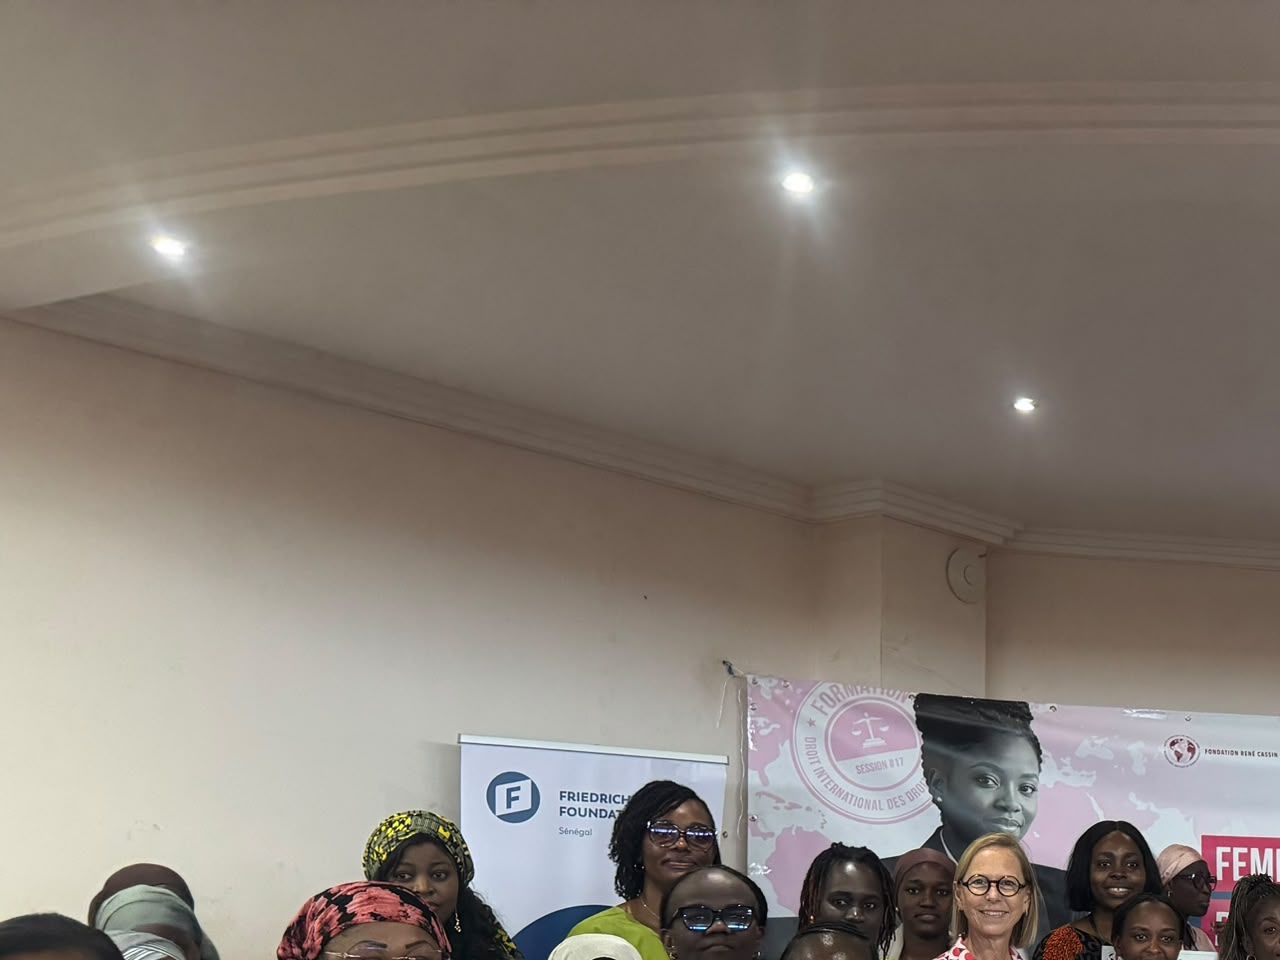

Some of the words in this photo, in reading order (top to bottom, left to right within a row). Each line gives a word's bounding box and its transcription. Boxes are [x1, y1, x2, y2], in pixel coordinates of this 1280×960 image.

[1204, 748, 1239, 757] FONDATION
[1240, 749, 1255, 757] RENÉ
[1257, 750, 1278, 758] CASSIN
[804, 736, 820, 768] DROIT
[813, 766, 883, 811] INTERNATIONAL
[887, 796, 906, 811] DES
[907, 781, 930, 802] DROI
[855, 760, 889, 775] SESSION
[506, 786, 521, 809] F
[559, 791, 631, 805] FRIEDRICH
[558, 827, 592, 838] Sénégal
